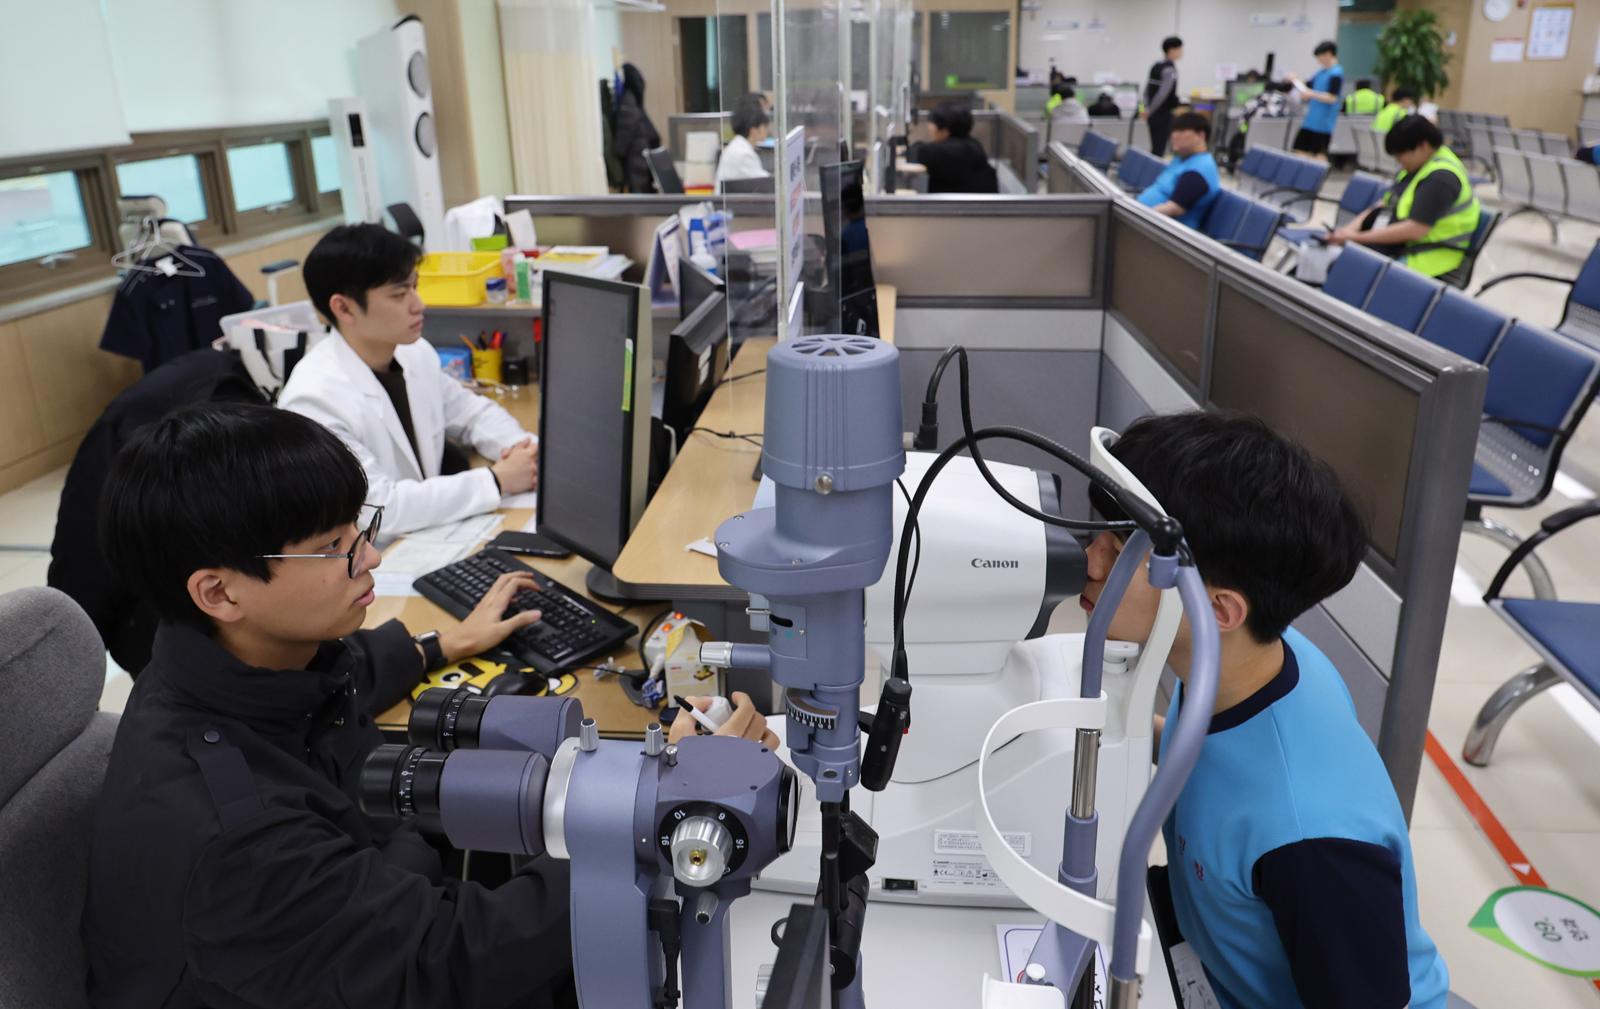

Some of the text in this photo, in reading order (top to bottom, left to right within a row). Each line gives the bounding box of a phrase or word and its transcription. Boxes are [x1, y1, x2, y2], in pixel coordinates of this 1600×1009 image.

[971, 558, 1018, 569] Canon
[674, 809, 686, 820] 10
[718, 812, 726, 820] 6
[661, 836, 670, 846] 16
[736, 839, 744, 848] 16
